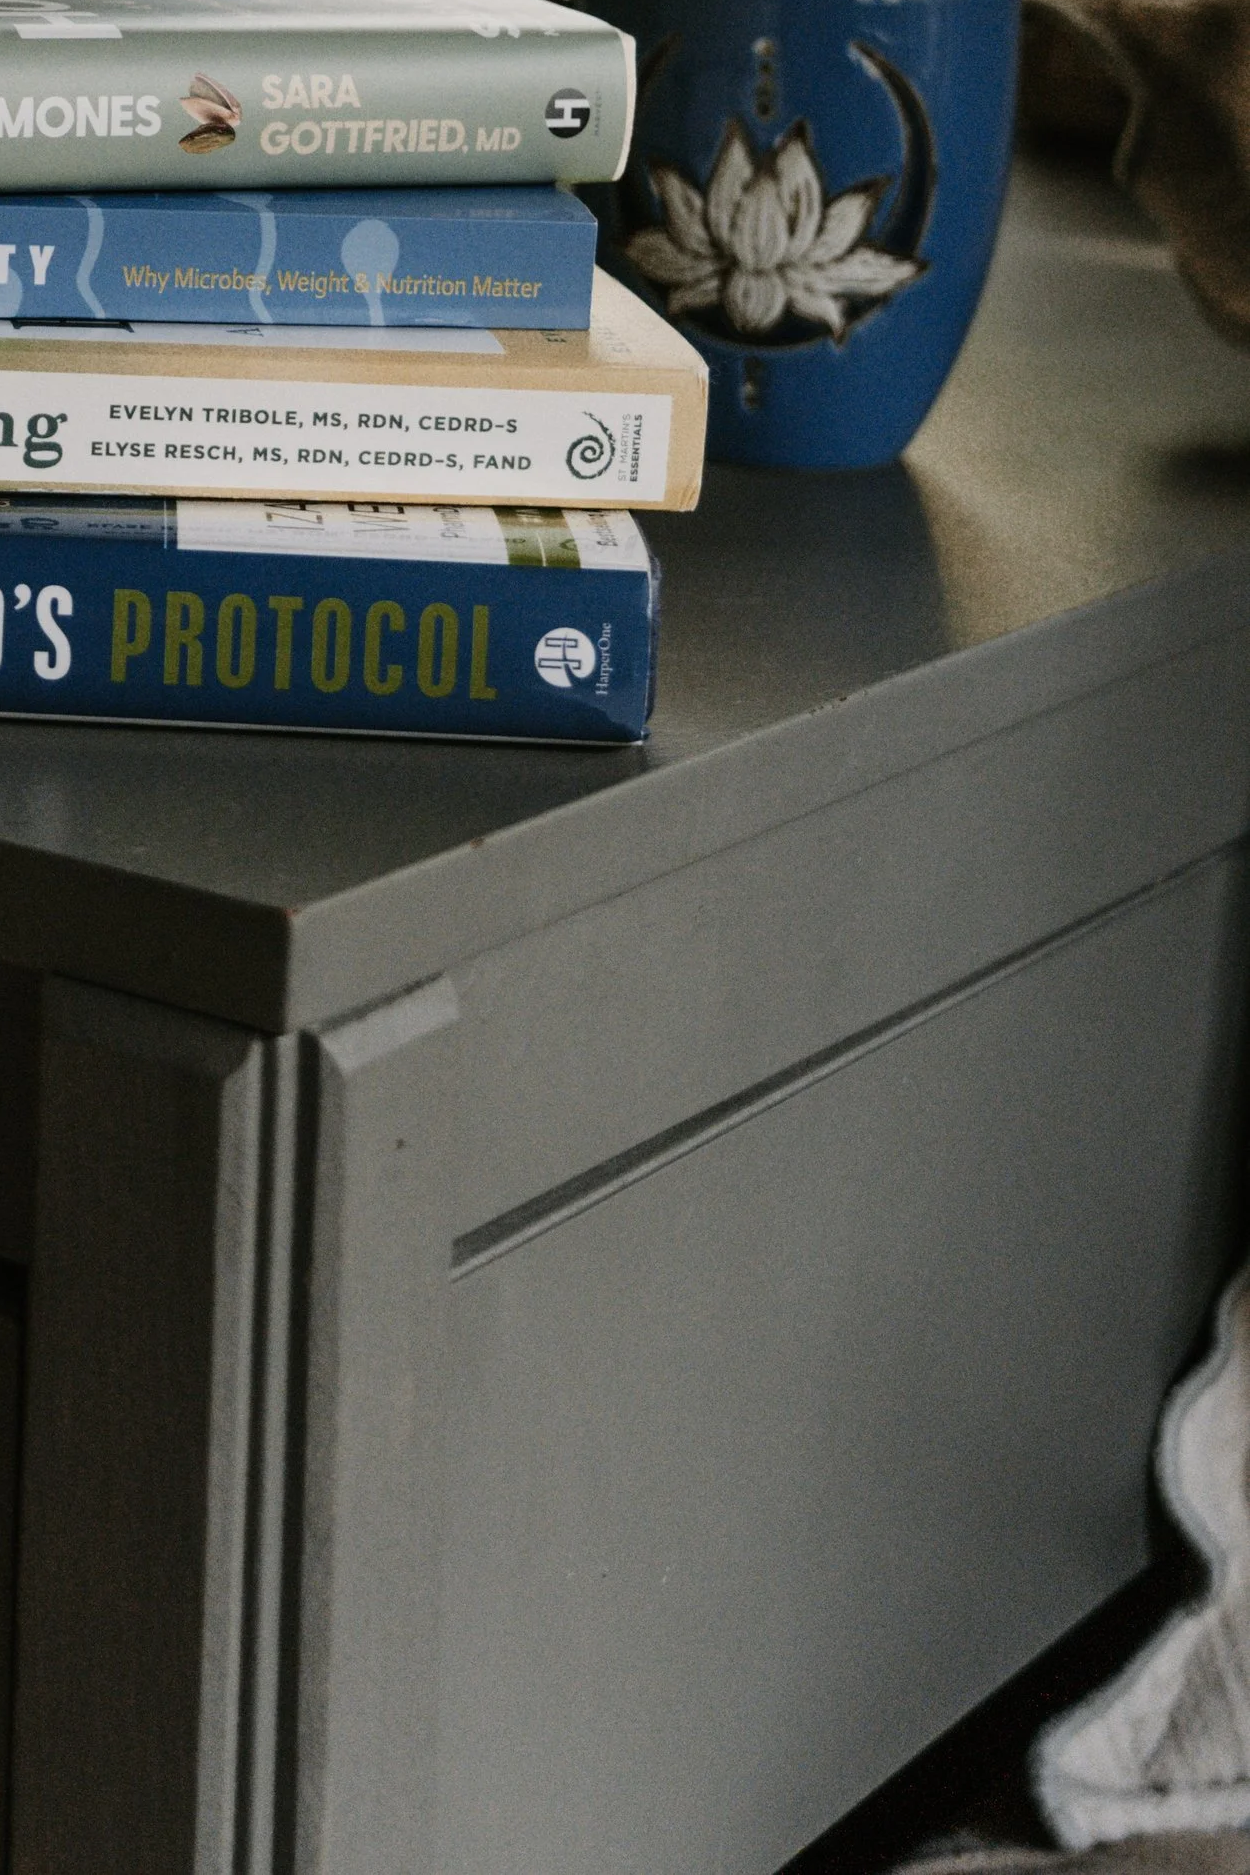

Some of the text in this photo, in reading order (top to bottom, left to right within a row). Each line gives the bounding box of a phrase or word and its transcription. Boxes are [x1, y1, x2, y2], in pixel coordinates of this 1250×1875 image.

[261, 74, 362, 109] SARA
[260, 119, 522, 155] GOTTFRIED, MD
[123, 265, 542, 299] Why Microbes, Weight & Nutrition Matter
[109, 404, 194, 422] EVELYN
[202, 408, 303, 428] TRIBOLE,
[312, 412, 348, 429] MS,
[357, 414, 410, 432] RDN,
[91, 441, 156, 458] ELYSE
[165, 444, 243, 463] RESCH,
[252, 447, 288, 465] MS,
[297, 449, 350, 467] RDN,
[473, 455, 532, 470] FAND
[630, 414, 643, 482] ESSENTIALS
[111, 589, 497, 701] PROTOCOL
[595, 623, 613, 695] HarperOne
